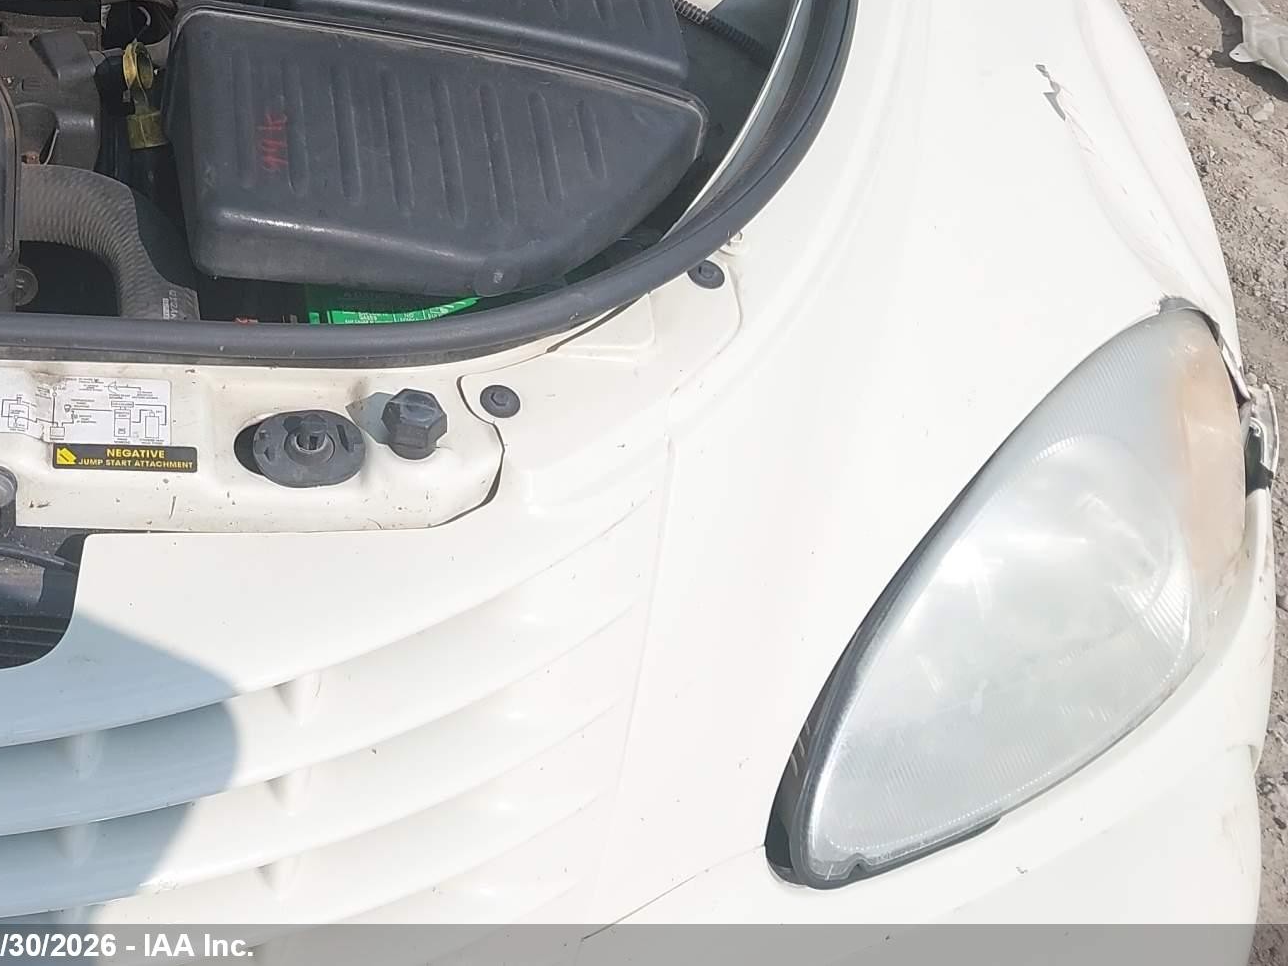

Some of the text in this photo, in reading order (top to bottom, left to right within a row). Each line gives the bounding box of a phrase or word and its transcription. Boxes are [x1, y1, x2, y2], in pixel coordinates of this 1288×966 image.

[106, 448, 165, 459] NEGATIVE
[78, 458, 193, 469] JUMP START ATTACHMENT
